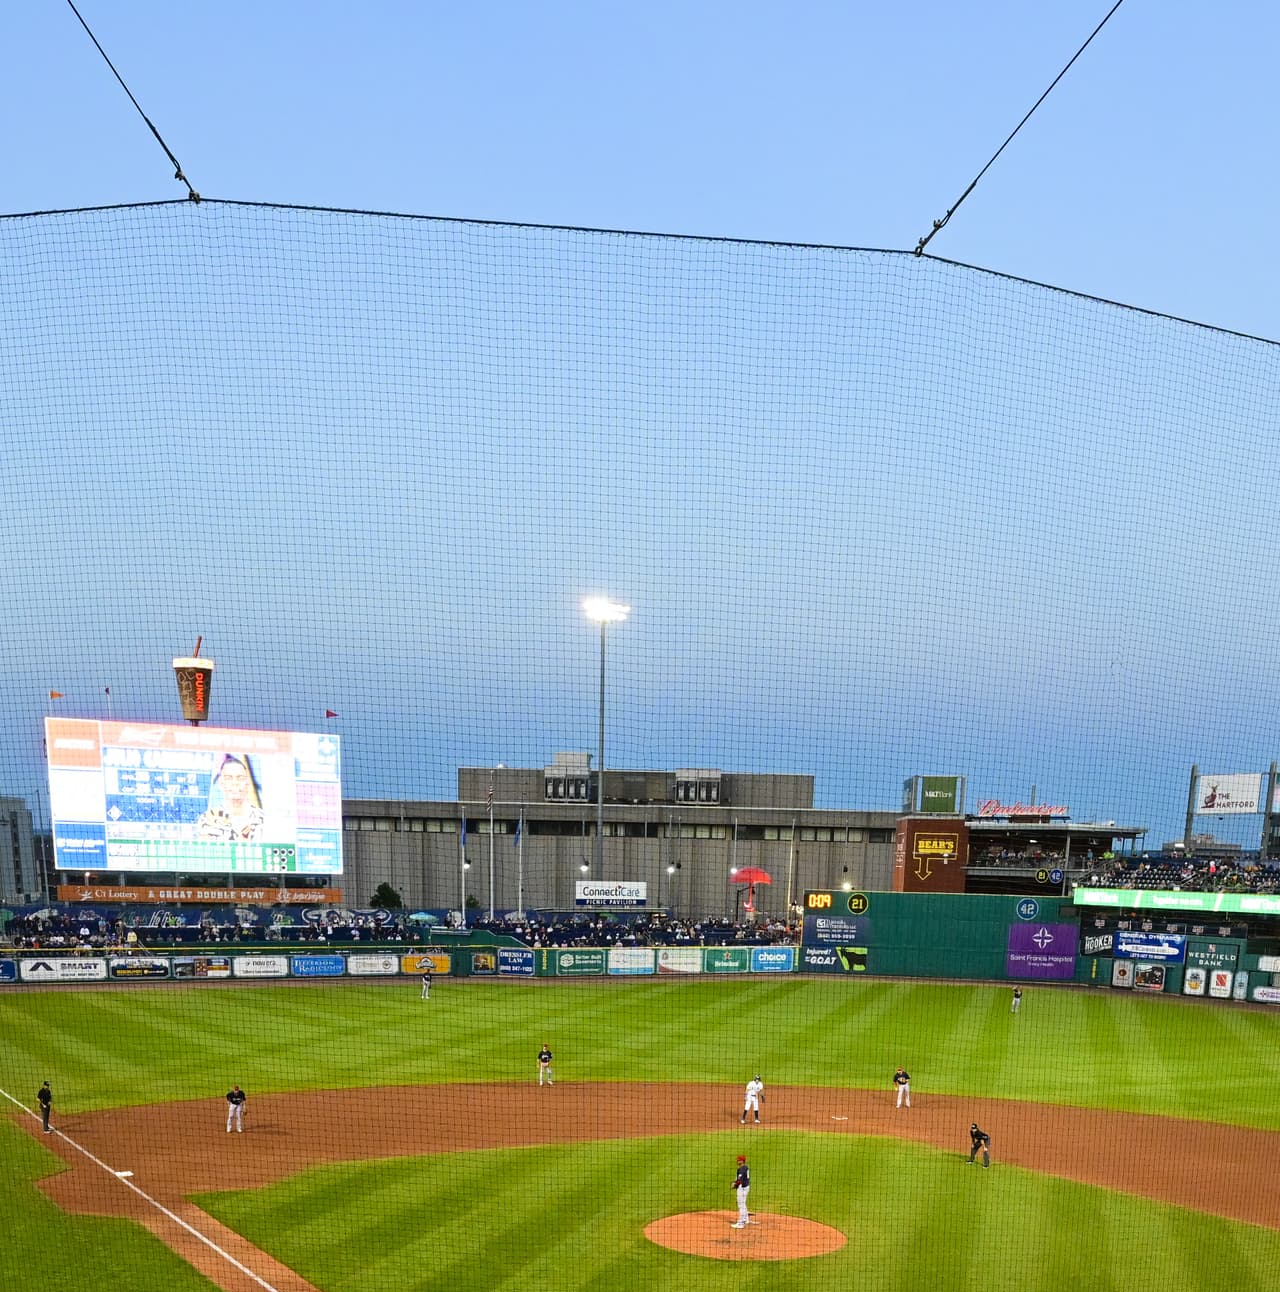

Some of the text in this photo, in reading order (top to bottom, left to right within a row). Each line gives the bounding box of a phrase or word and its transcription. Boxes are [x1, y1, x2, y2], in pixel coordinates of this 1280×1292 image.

[1218, 792, 1231, 800] THE
[1216, 800, 1255, 809] HARTFORD
[918, 841, 954, 850] BEAR'S
[107, 889, 139, 900] Lottery
[159, 890, 193, 898] GREAT
[196, 890, 237, 899] DOUBLE
[240, 891, 265, 899] PLAY
[582, 885, 640, 897] ConnectiCare
[808, 894, 832, 909] 0:09
[851, 898, 864, 909] 21
[1020, 903, 1035, 915] 42
[1085, 935, 1113, 950] HOOKER
[499, 951, 532, 959] DRESSLER
[758, 951, 787, 961] choice
[1048, 955, 1073, 964] Hospital
[1188, 951, 1237, 961] WESTFIELD
[1198, 959, 1223, 967] BANK
